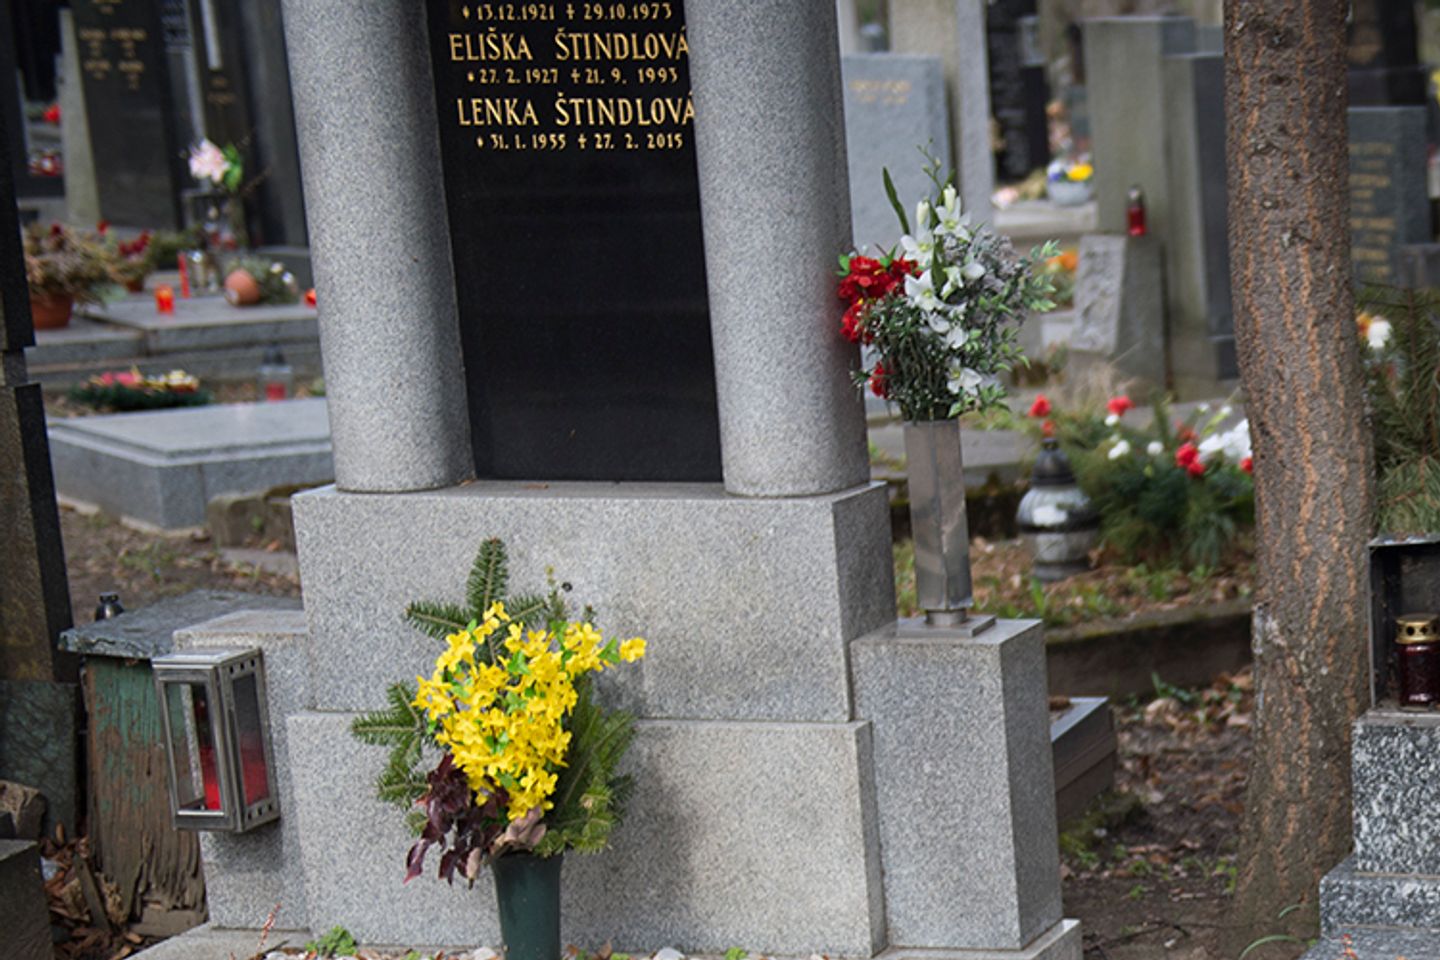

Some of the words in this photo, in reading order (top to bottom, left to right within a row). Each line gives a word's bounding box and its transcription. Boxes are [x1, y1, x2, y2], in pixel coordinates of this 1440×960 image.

[583, 3, 672, 20] 29.10.1973
[448, 26, 534, 60] ELIŠKA
[554, 25, 689, 60] ŠTINDLOVÁ
[525, 68, 558, 84] 1927
[638, 67, 678, 84] 1993
[457, 98, 539, 126] LENKA
[554, 90, 695, 126] ŠTINDLOVÁ
[531, 134, 566, 149] 1955
[647, 132, 683, 149] 2015
